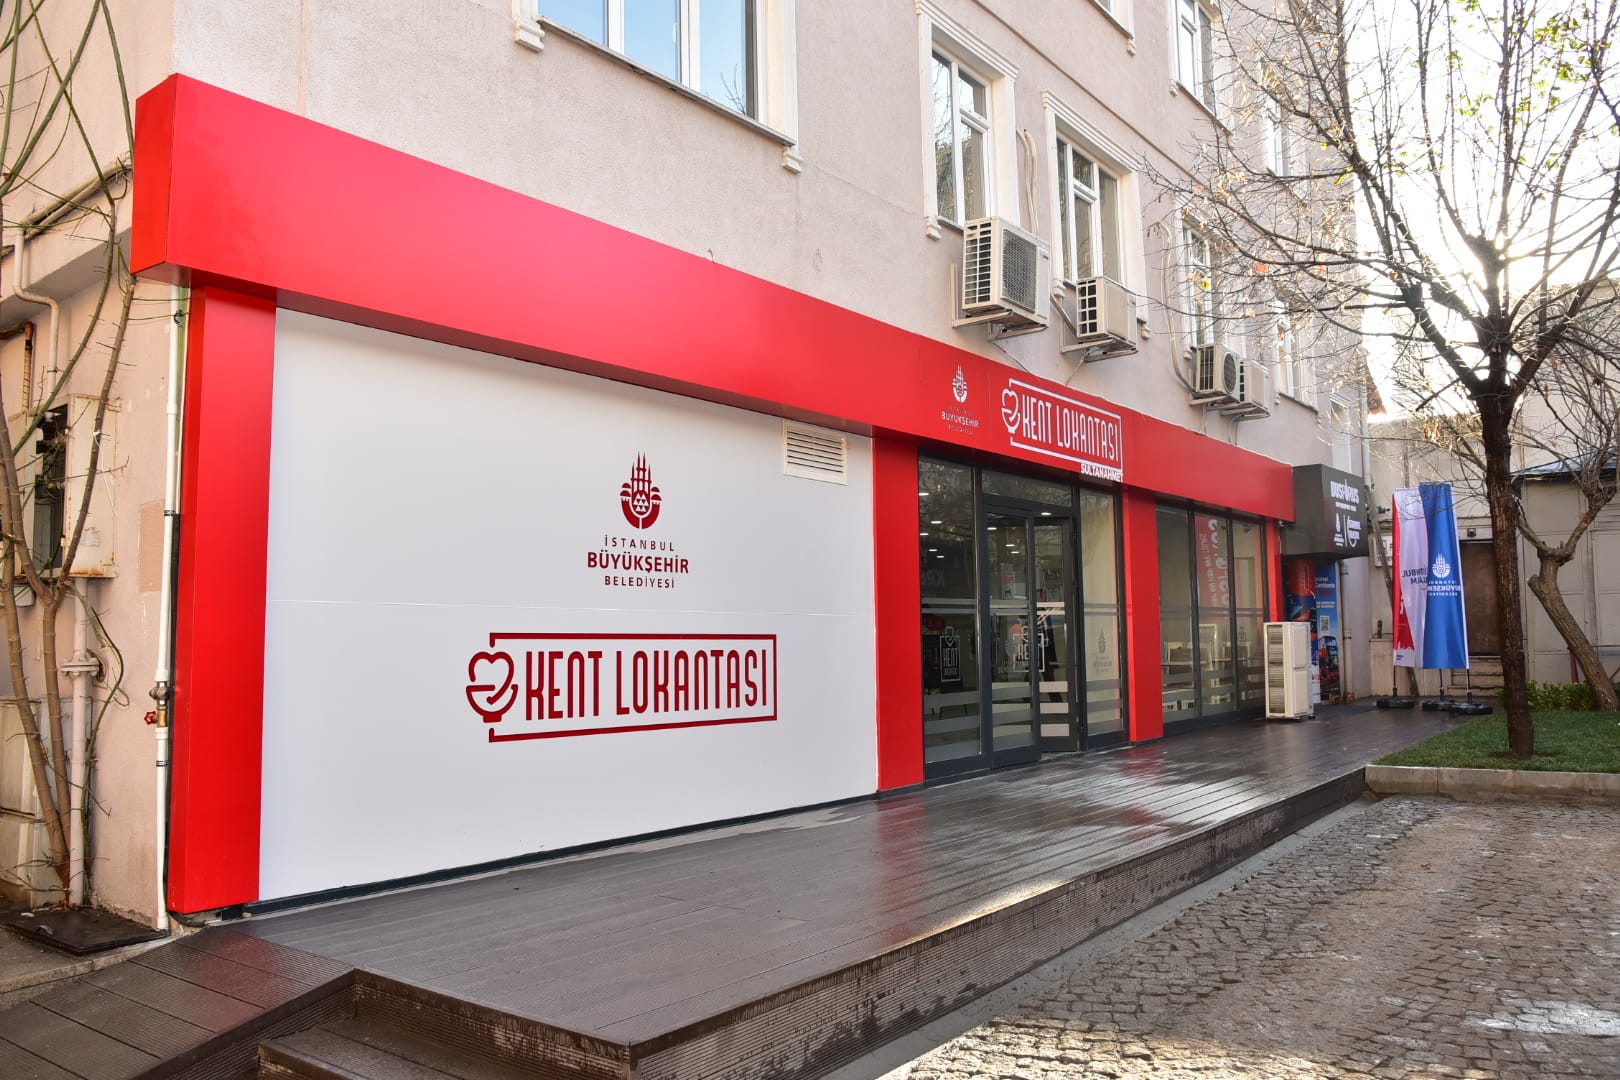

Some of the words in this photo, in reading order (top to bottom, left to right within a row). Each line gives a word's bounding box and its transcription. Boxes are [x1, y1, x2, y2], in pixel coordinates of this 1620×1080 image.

[1022, 394, 1053, 445] KENT
[1056, 405, 1120, 463] LOKANTASI
[604, 534, 676, 552] İSTANBUL
[587, 550, 690, 574] BÜYÜKŞEHİR
[604, 575, 676, 589] BELEDİYESİ
[525, 651, 603, 721] KENT
[616, 649, 768, 716] LOKANTASI
